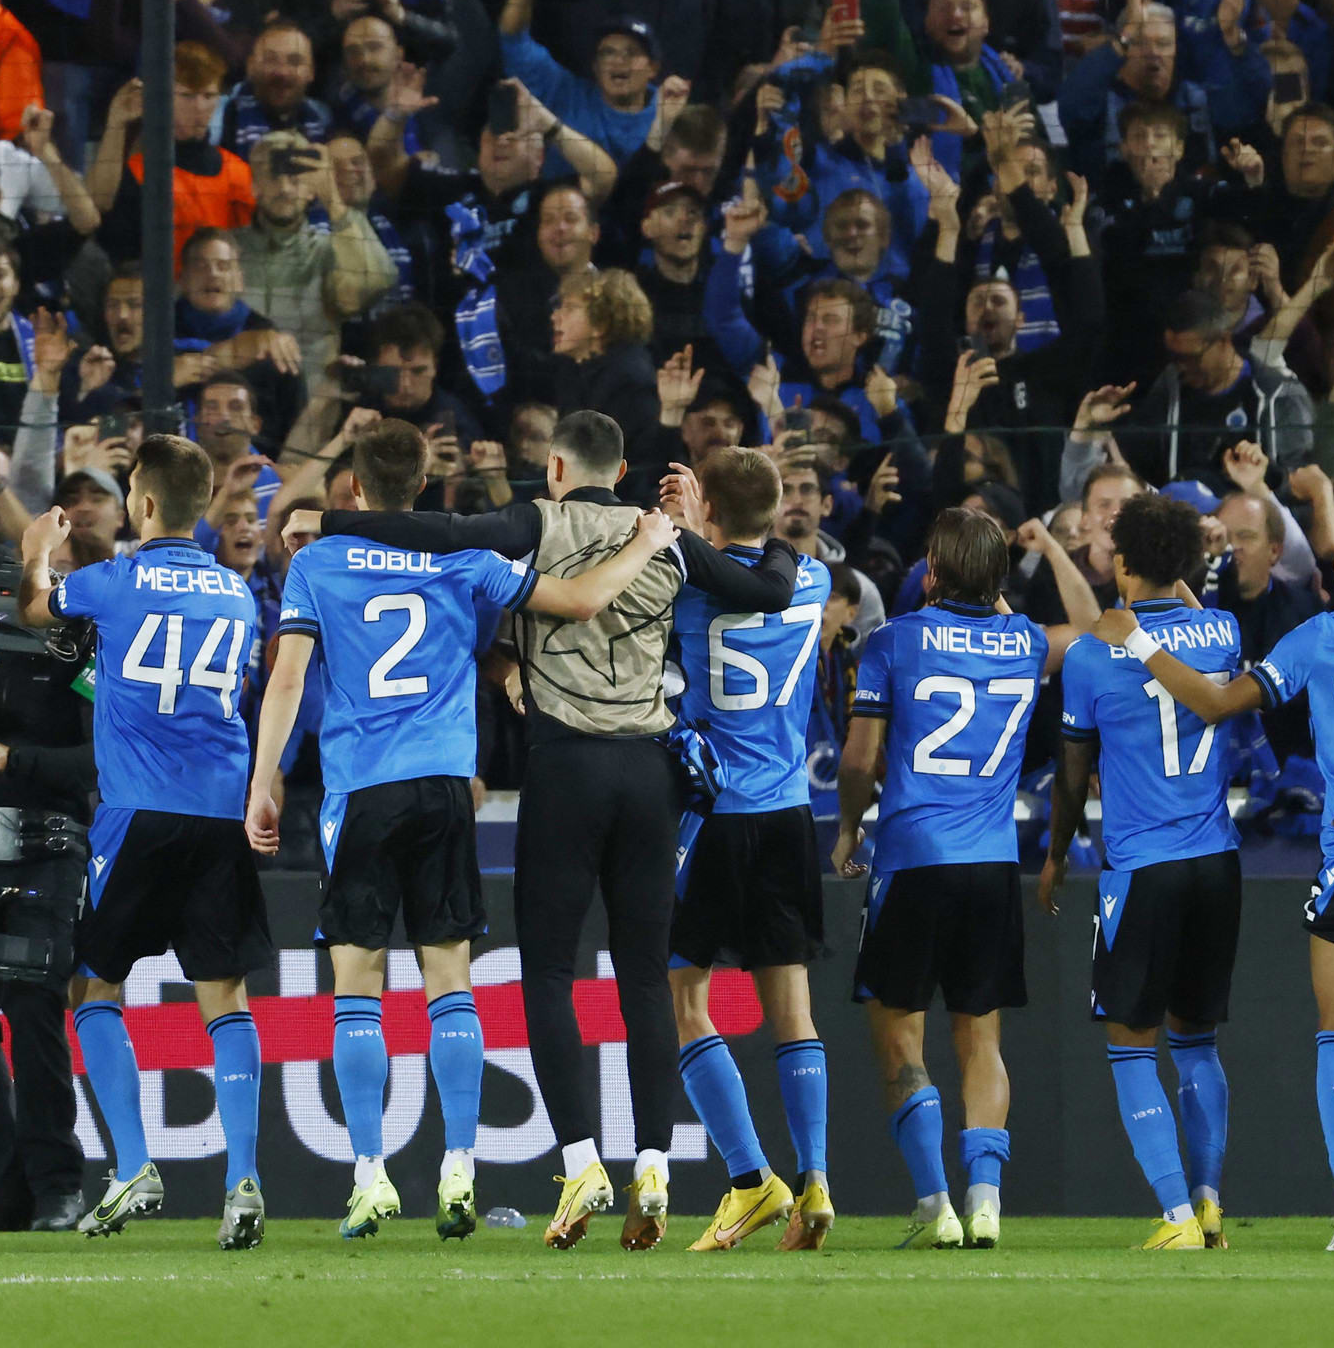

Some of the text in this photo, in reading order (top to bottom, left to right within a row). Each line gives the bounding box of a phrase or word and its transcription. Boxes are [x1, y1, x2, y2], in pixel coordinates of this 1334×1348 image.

[135, 567, 245, 598] MECHELE
[363, 593, 428, 699] 2
[708, 603, 822, 712] 67
[922, 626, 1032, 657] NIELSEN
[1110, 619, 1234, 660] BHANAN
[121, 613, 246, 720] 44
[913, 675, 1034, 777] 27
[1143, 670, 1230, 777] 17
[346, 1028, 379, 1038] 1891
[440, 1030, 476, 1040] 1891
[1132, 1106, 1163, 1121] 1891
